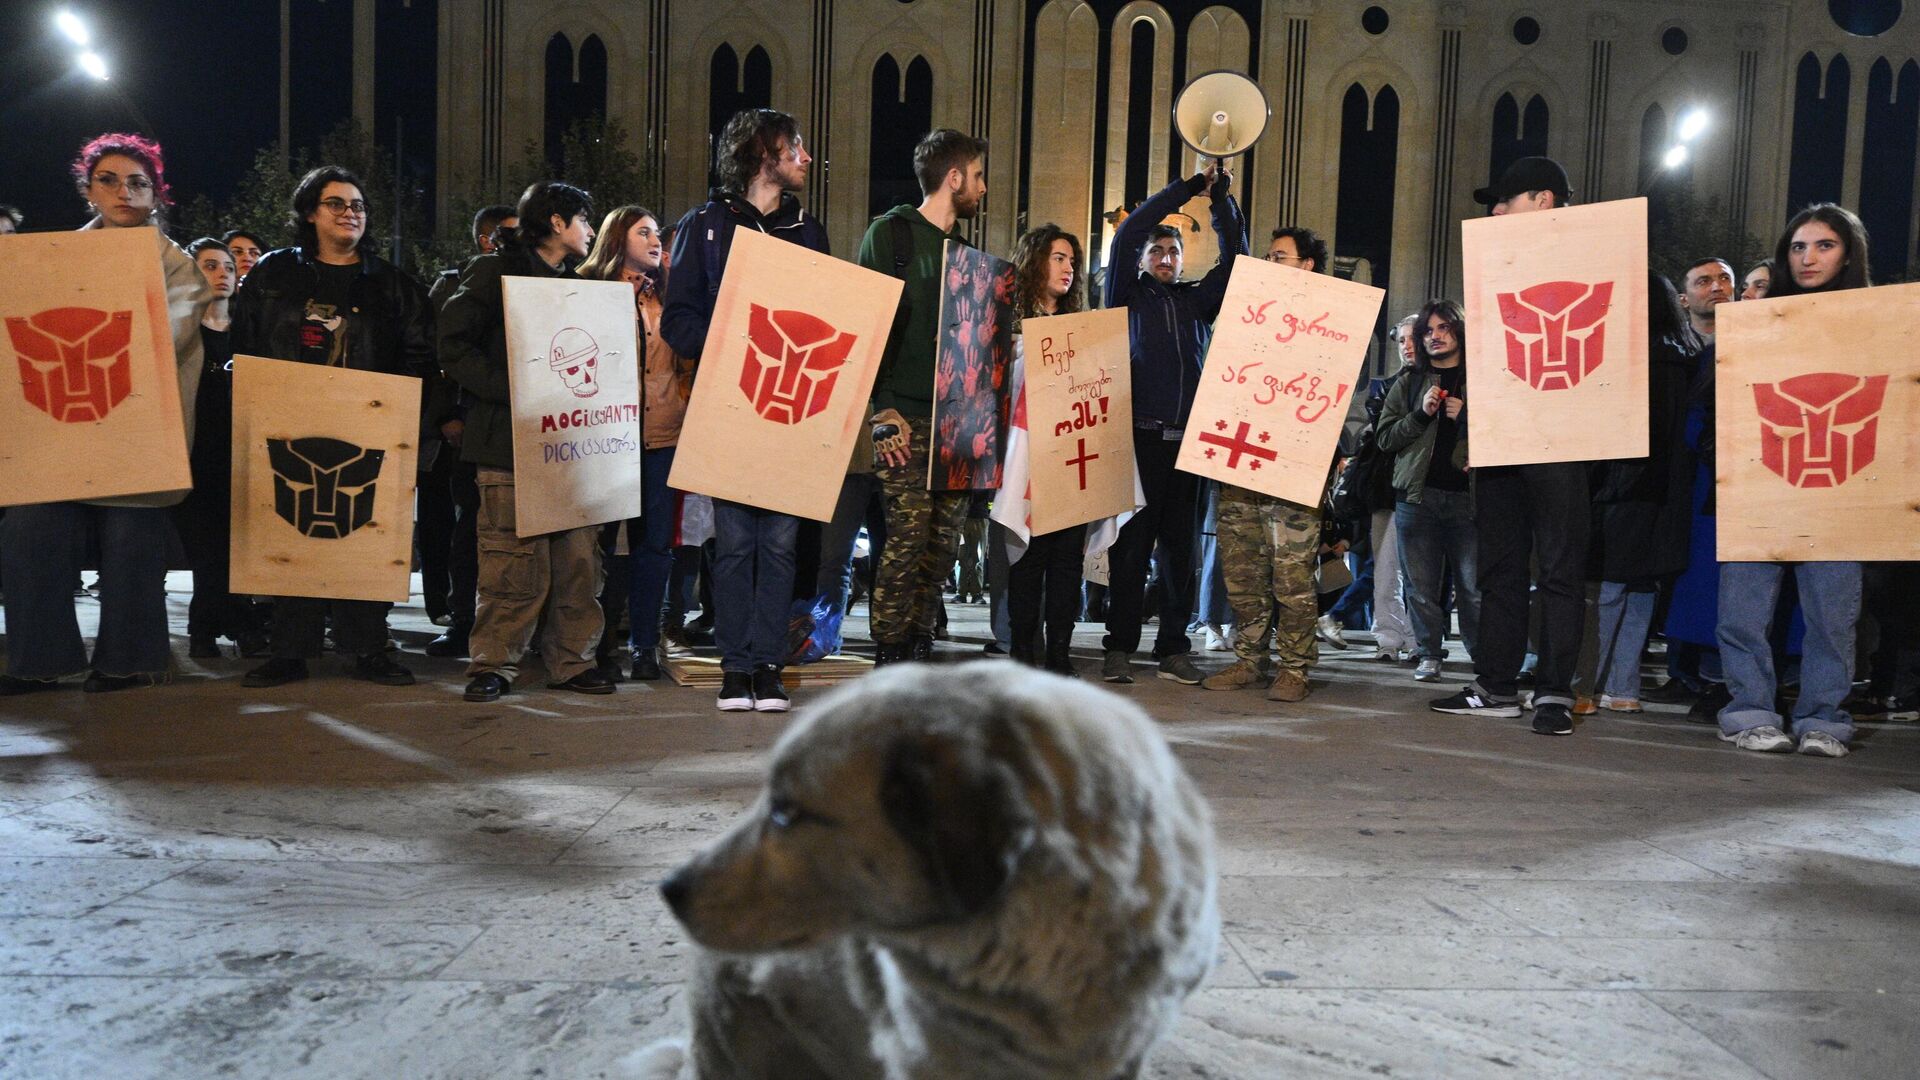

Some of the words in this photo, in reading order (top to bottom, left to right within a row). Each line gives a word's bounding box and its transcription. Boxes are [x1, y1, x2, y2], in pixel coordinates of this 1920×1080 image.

[1241, 300, 1277, 325] ან
[1275, 311, 1349, 343] ფარით
[1041, 332, 1075, 376] ჩვენ
[1221, 362, 1264, 385] ან
[1055, 396, 1110, 437] ომს!
[1465, 695, 1485, 708] N
